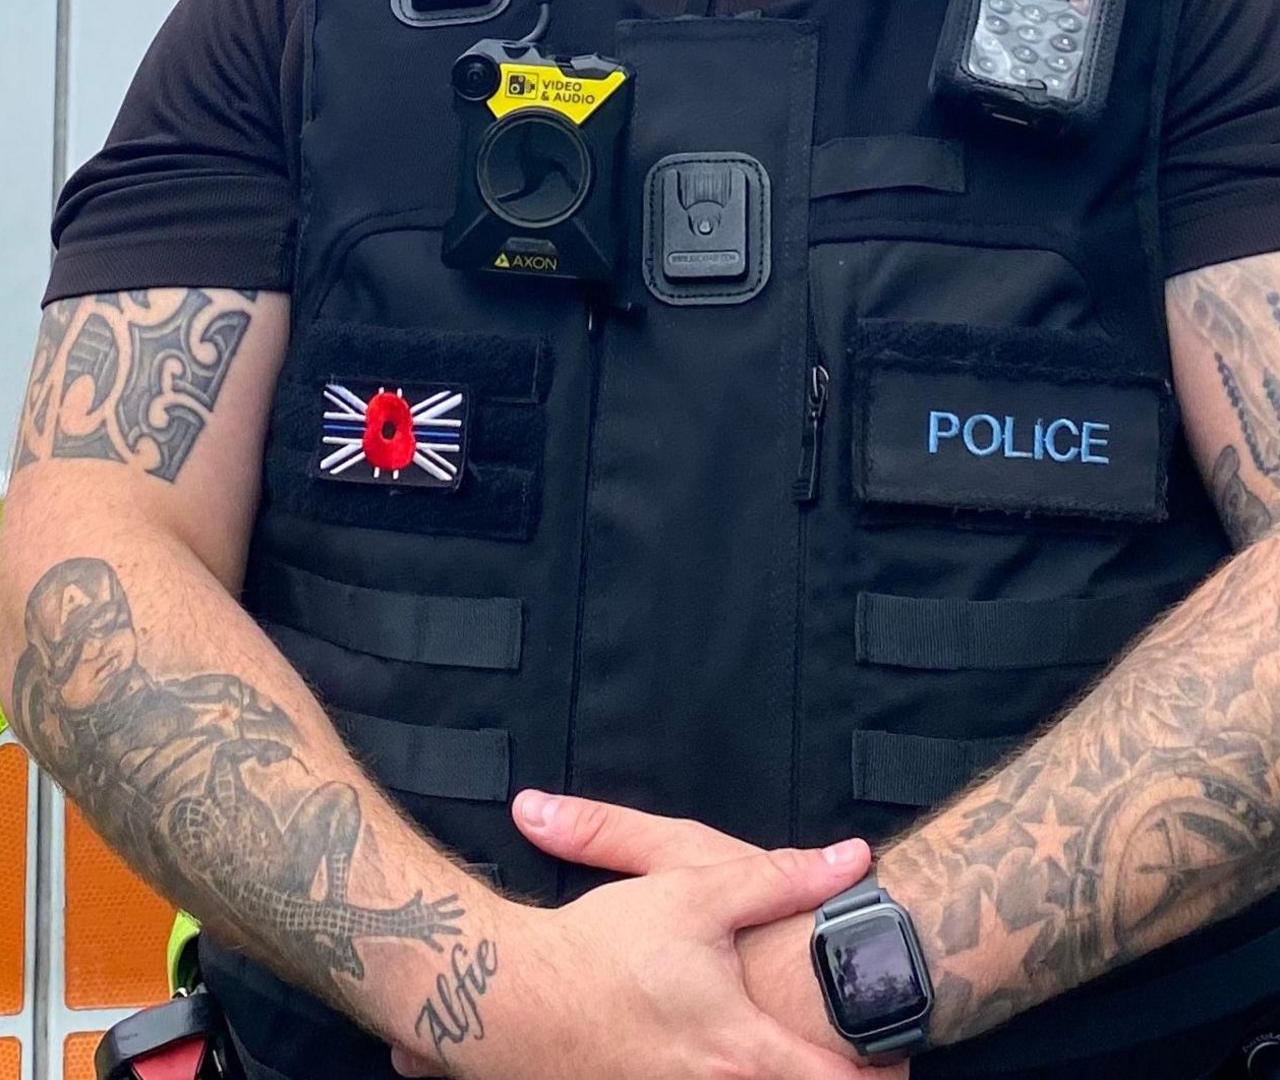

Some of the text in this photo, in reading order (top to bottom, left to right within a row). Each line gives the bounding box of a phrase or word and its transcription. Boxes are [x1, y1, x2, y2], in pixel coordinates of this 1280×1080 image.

[542, 80, 582, 92] VIDEO
[541, 92, 595, 104] & AUDIO
[512, 255, 557, 270] AXON
[928, 410, 1110, 464] POLICE
[415, 939, 498, 1069] Alfie
